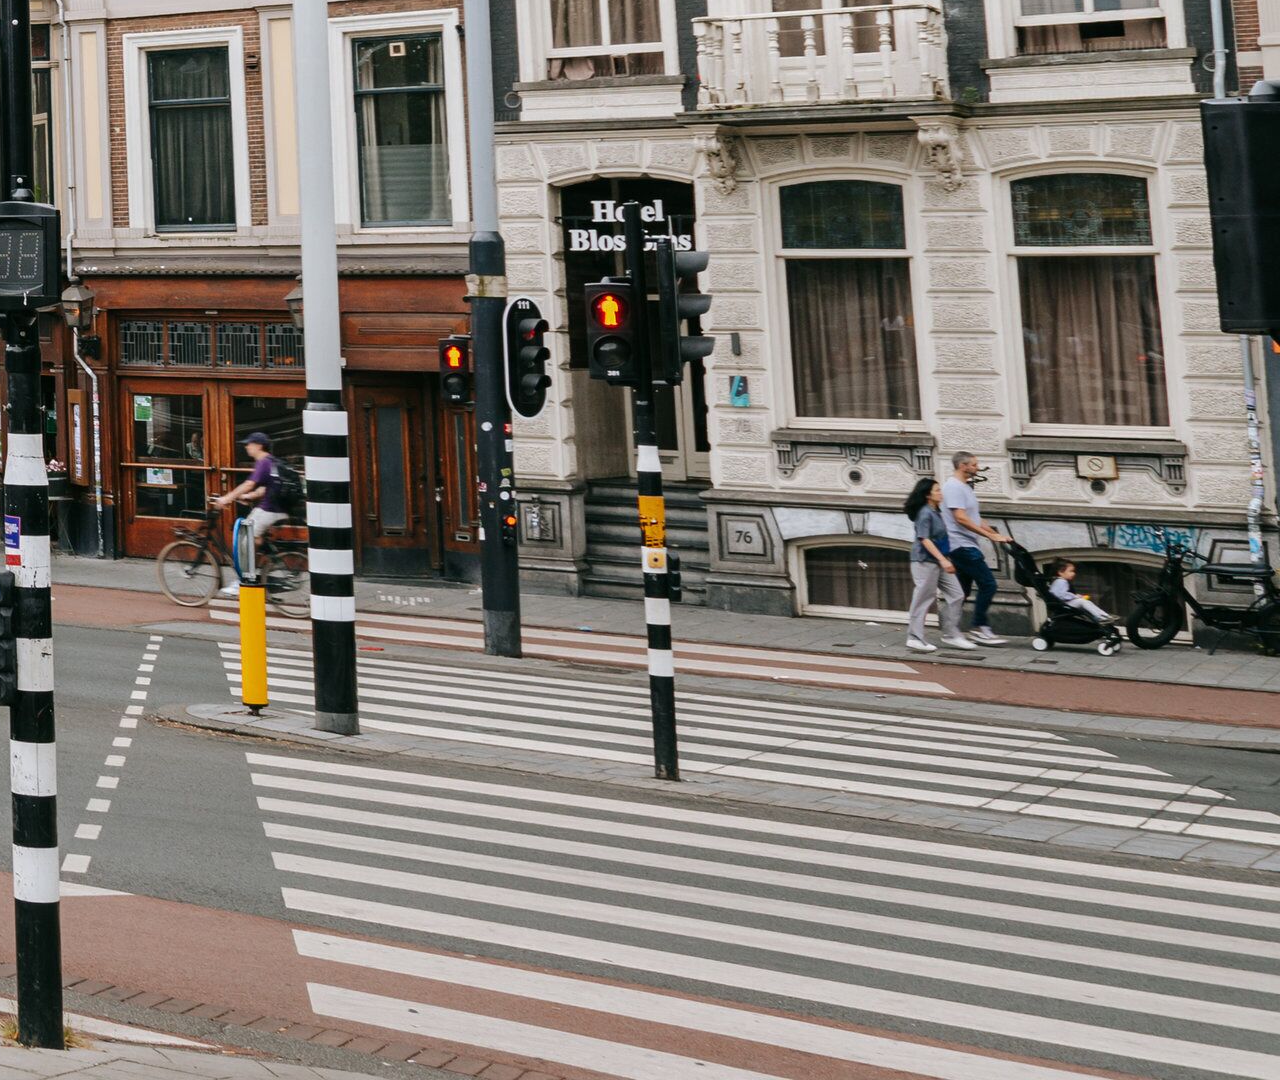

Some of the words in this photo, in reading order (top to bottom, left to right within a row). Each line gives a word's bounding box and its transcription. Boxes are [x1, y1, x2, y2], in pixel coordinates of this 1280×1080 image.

[590, 199, 665, 222] Hoel
[568, 229, 692, 252] Bloss
[517, 301, 530, 309] 111
[735, 531, 753, 544] 76
